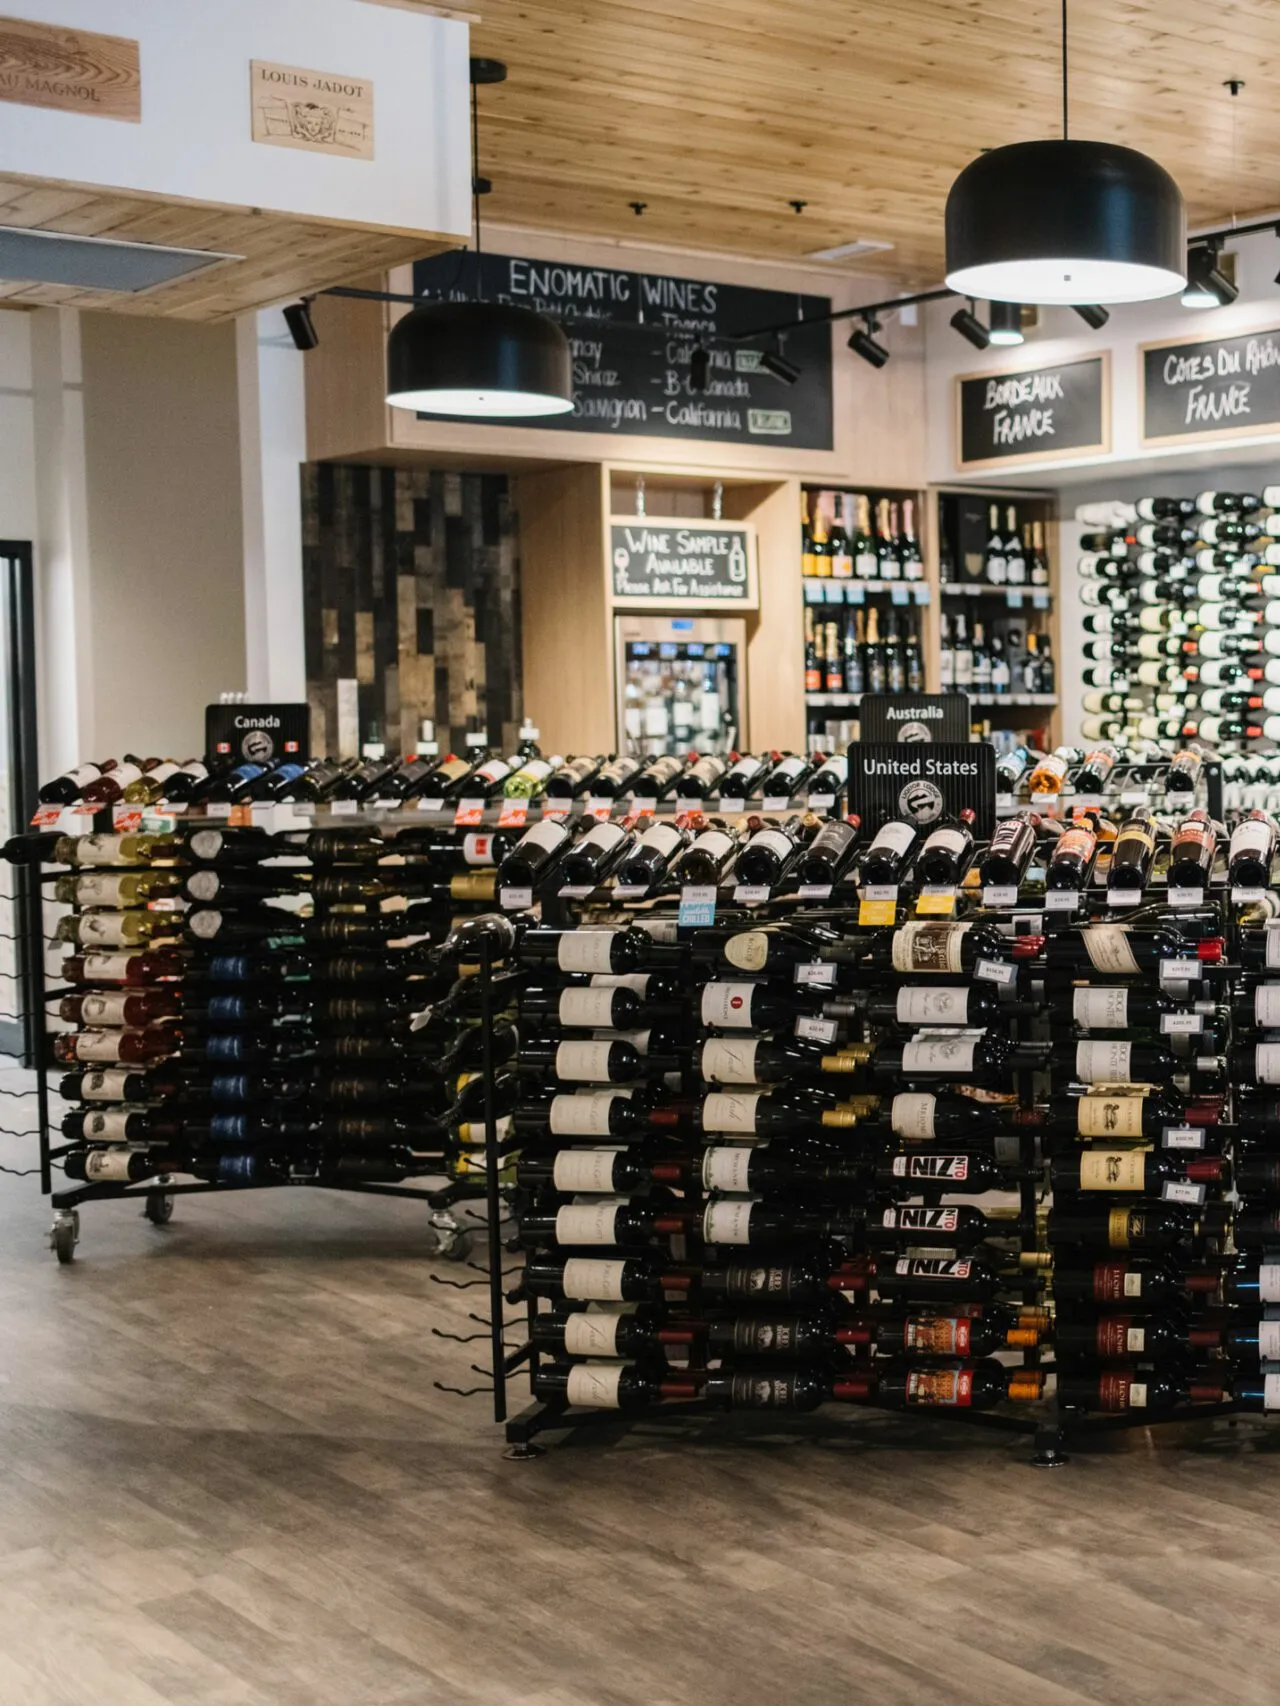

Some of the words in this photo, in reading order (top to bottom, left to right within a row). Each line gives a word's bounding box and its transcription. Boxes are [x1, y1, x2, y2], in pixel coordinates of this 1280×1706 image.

[25, 77, 101, 103] MAGNOL
[261, 68, 309, 88] LOUIS
[312, 79, 364, 98] JADOT
[509, 259, 631, 302] ENOMATIC
[642, 276, 718, 314] WINES
[983, 374, 1065, 411] BORDEAUX
[1185, 384, 1251, 425] FRANCE
[571, 391, 647, 428] Sauvignon
[665, 400, 742, 430] California
[993, 407, 1056, 445] FRANCE
[624, 527, 671, 554] WINE
[676, 530, 729, 555] SAMPLE
[645, 552, 715, 576] AVAILABLE
[234, 715, 281, 729] Canada
[886, 705, 944, 720] Australia
[863, 758, 921, 775] United
[925, 758, 978, 775] States
